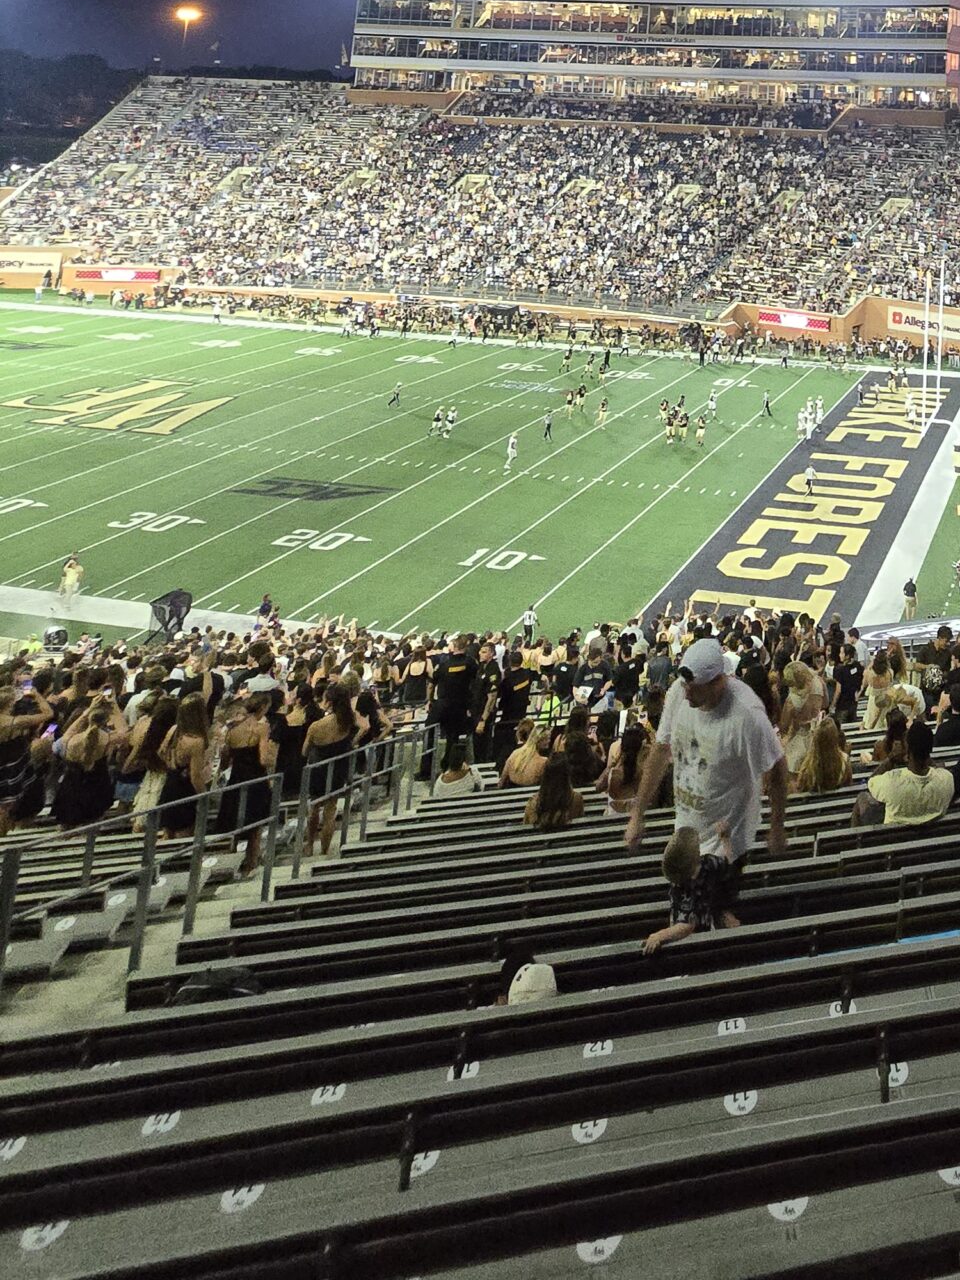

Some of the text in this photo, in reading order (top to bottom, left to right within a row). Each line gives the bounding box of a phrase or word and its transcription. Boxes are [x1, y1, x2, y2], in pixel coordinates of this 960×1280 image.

[712, 378, 752, 387] 10
[107, 511, 191, 532] 30
[270, 528, 355, 551] 20
[690, 451, 910, 628] FOREST
[456, 547, 528, 570] 10
[725, 1020, 739, 1031] 11
[589, 1041, 606, 1052] 12
